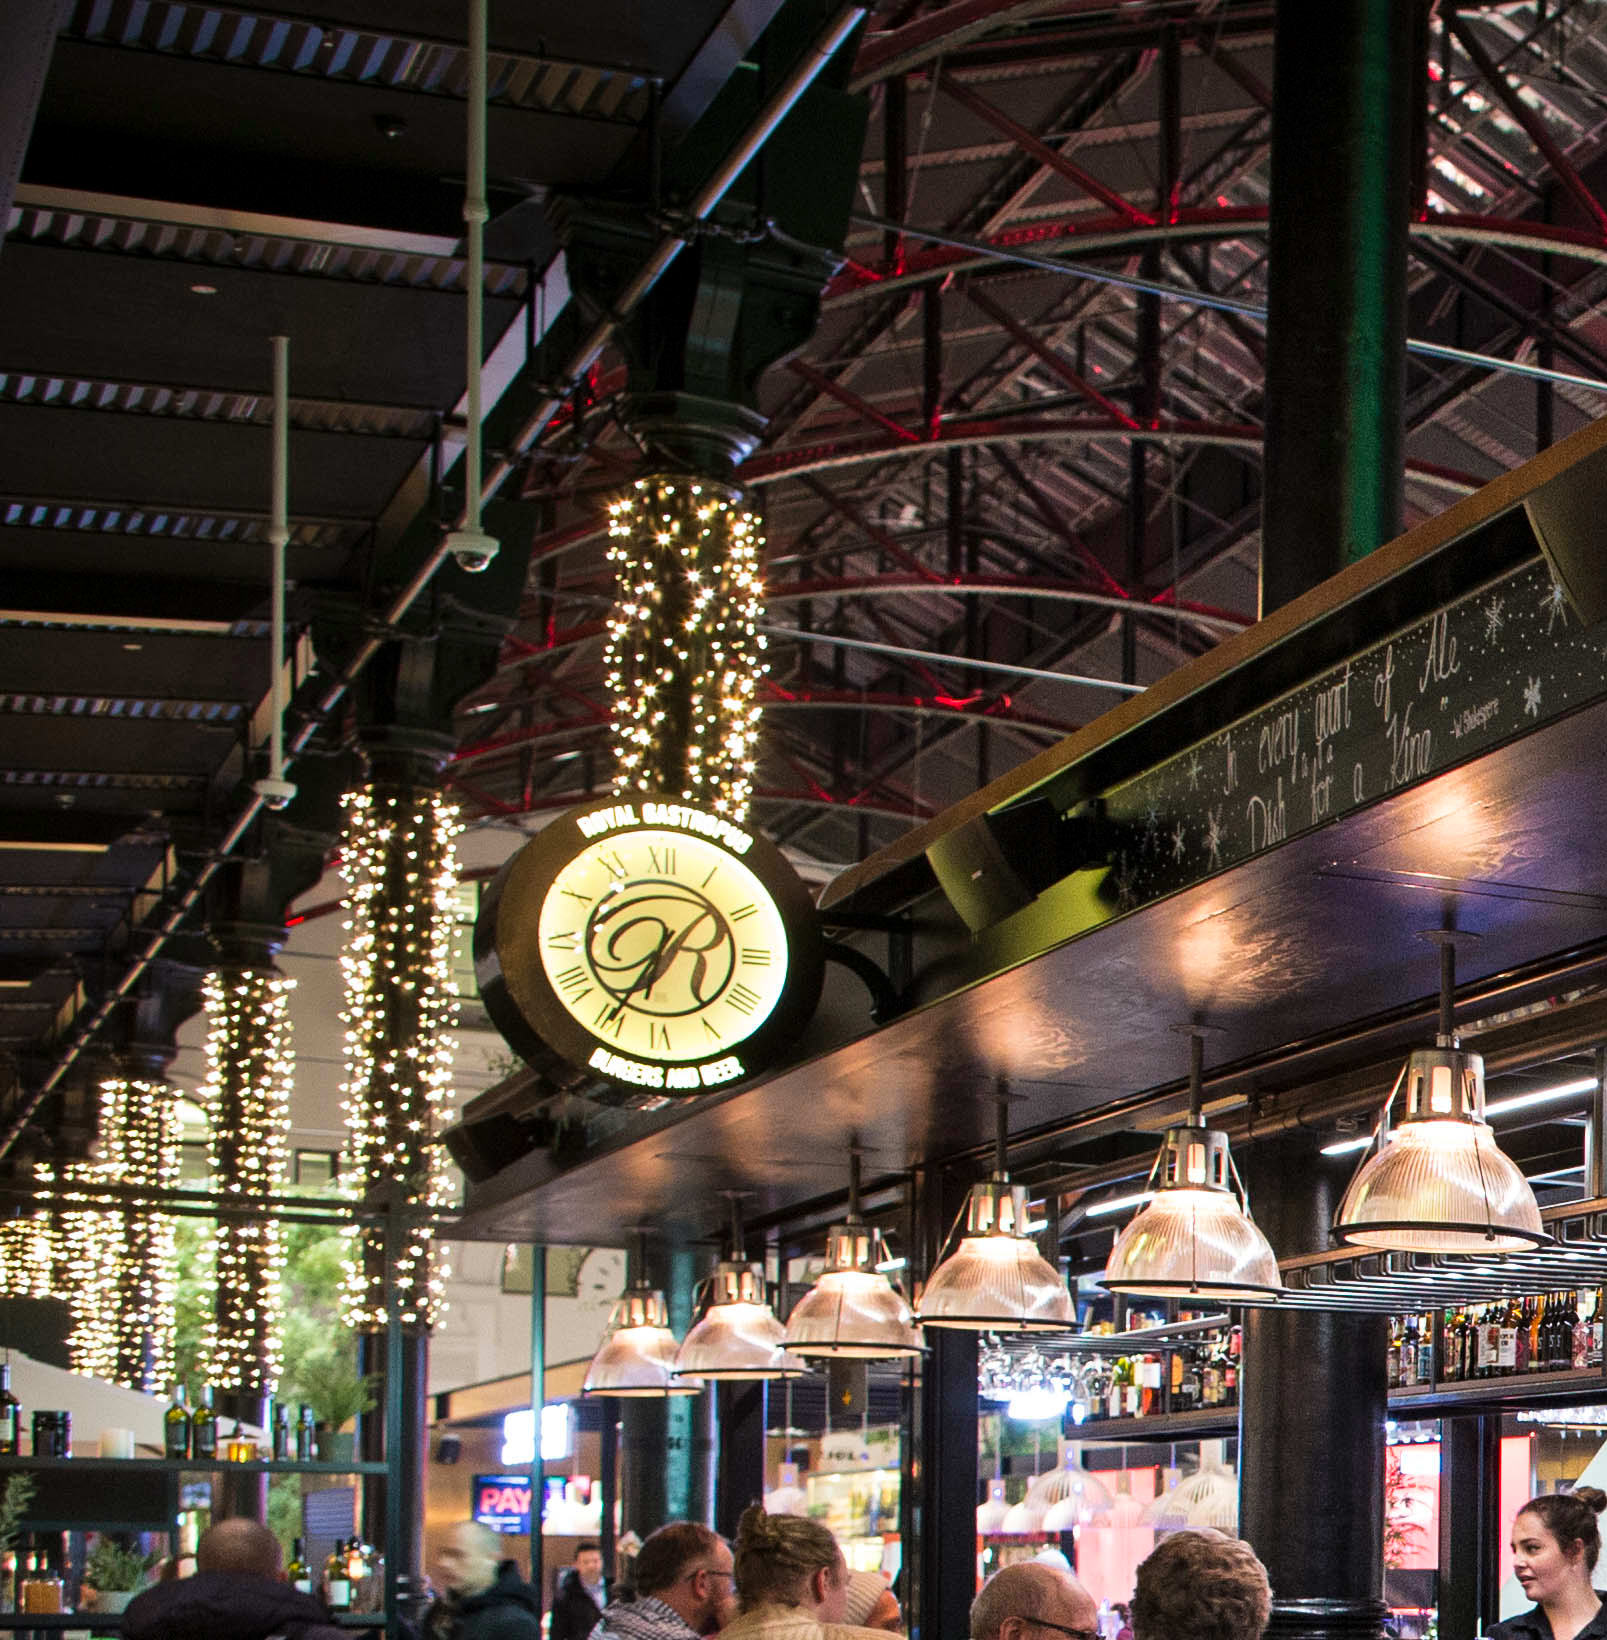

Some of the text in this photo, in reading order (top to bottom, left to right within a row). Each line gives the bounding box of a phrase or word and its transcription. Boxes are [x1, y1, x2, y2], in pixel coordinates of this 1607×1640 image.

[1259, 708, 1300, 784] every
[1374, 645, 1396, 723] of
[1420, 612, 1461, 693] Ale
[576, 802, 754, 855] ROYAL GASTROPUB
[1247, 776, 1287, 853] Dish
[1311, 757, 1334, 825] for
[1353, 763, 1365, 803] a
[588, 1047, 746, 1089] BURGERS AND BEER
[480, 1487, 532, 1514] PAY
